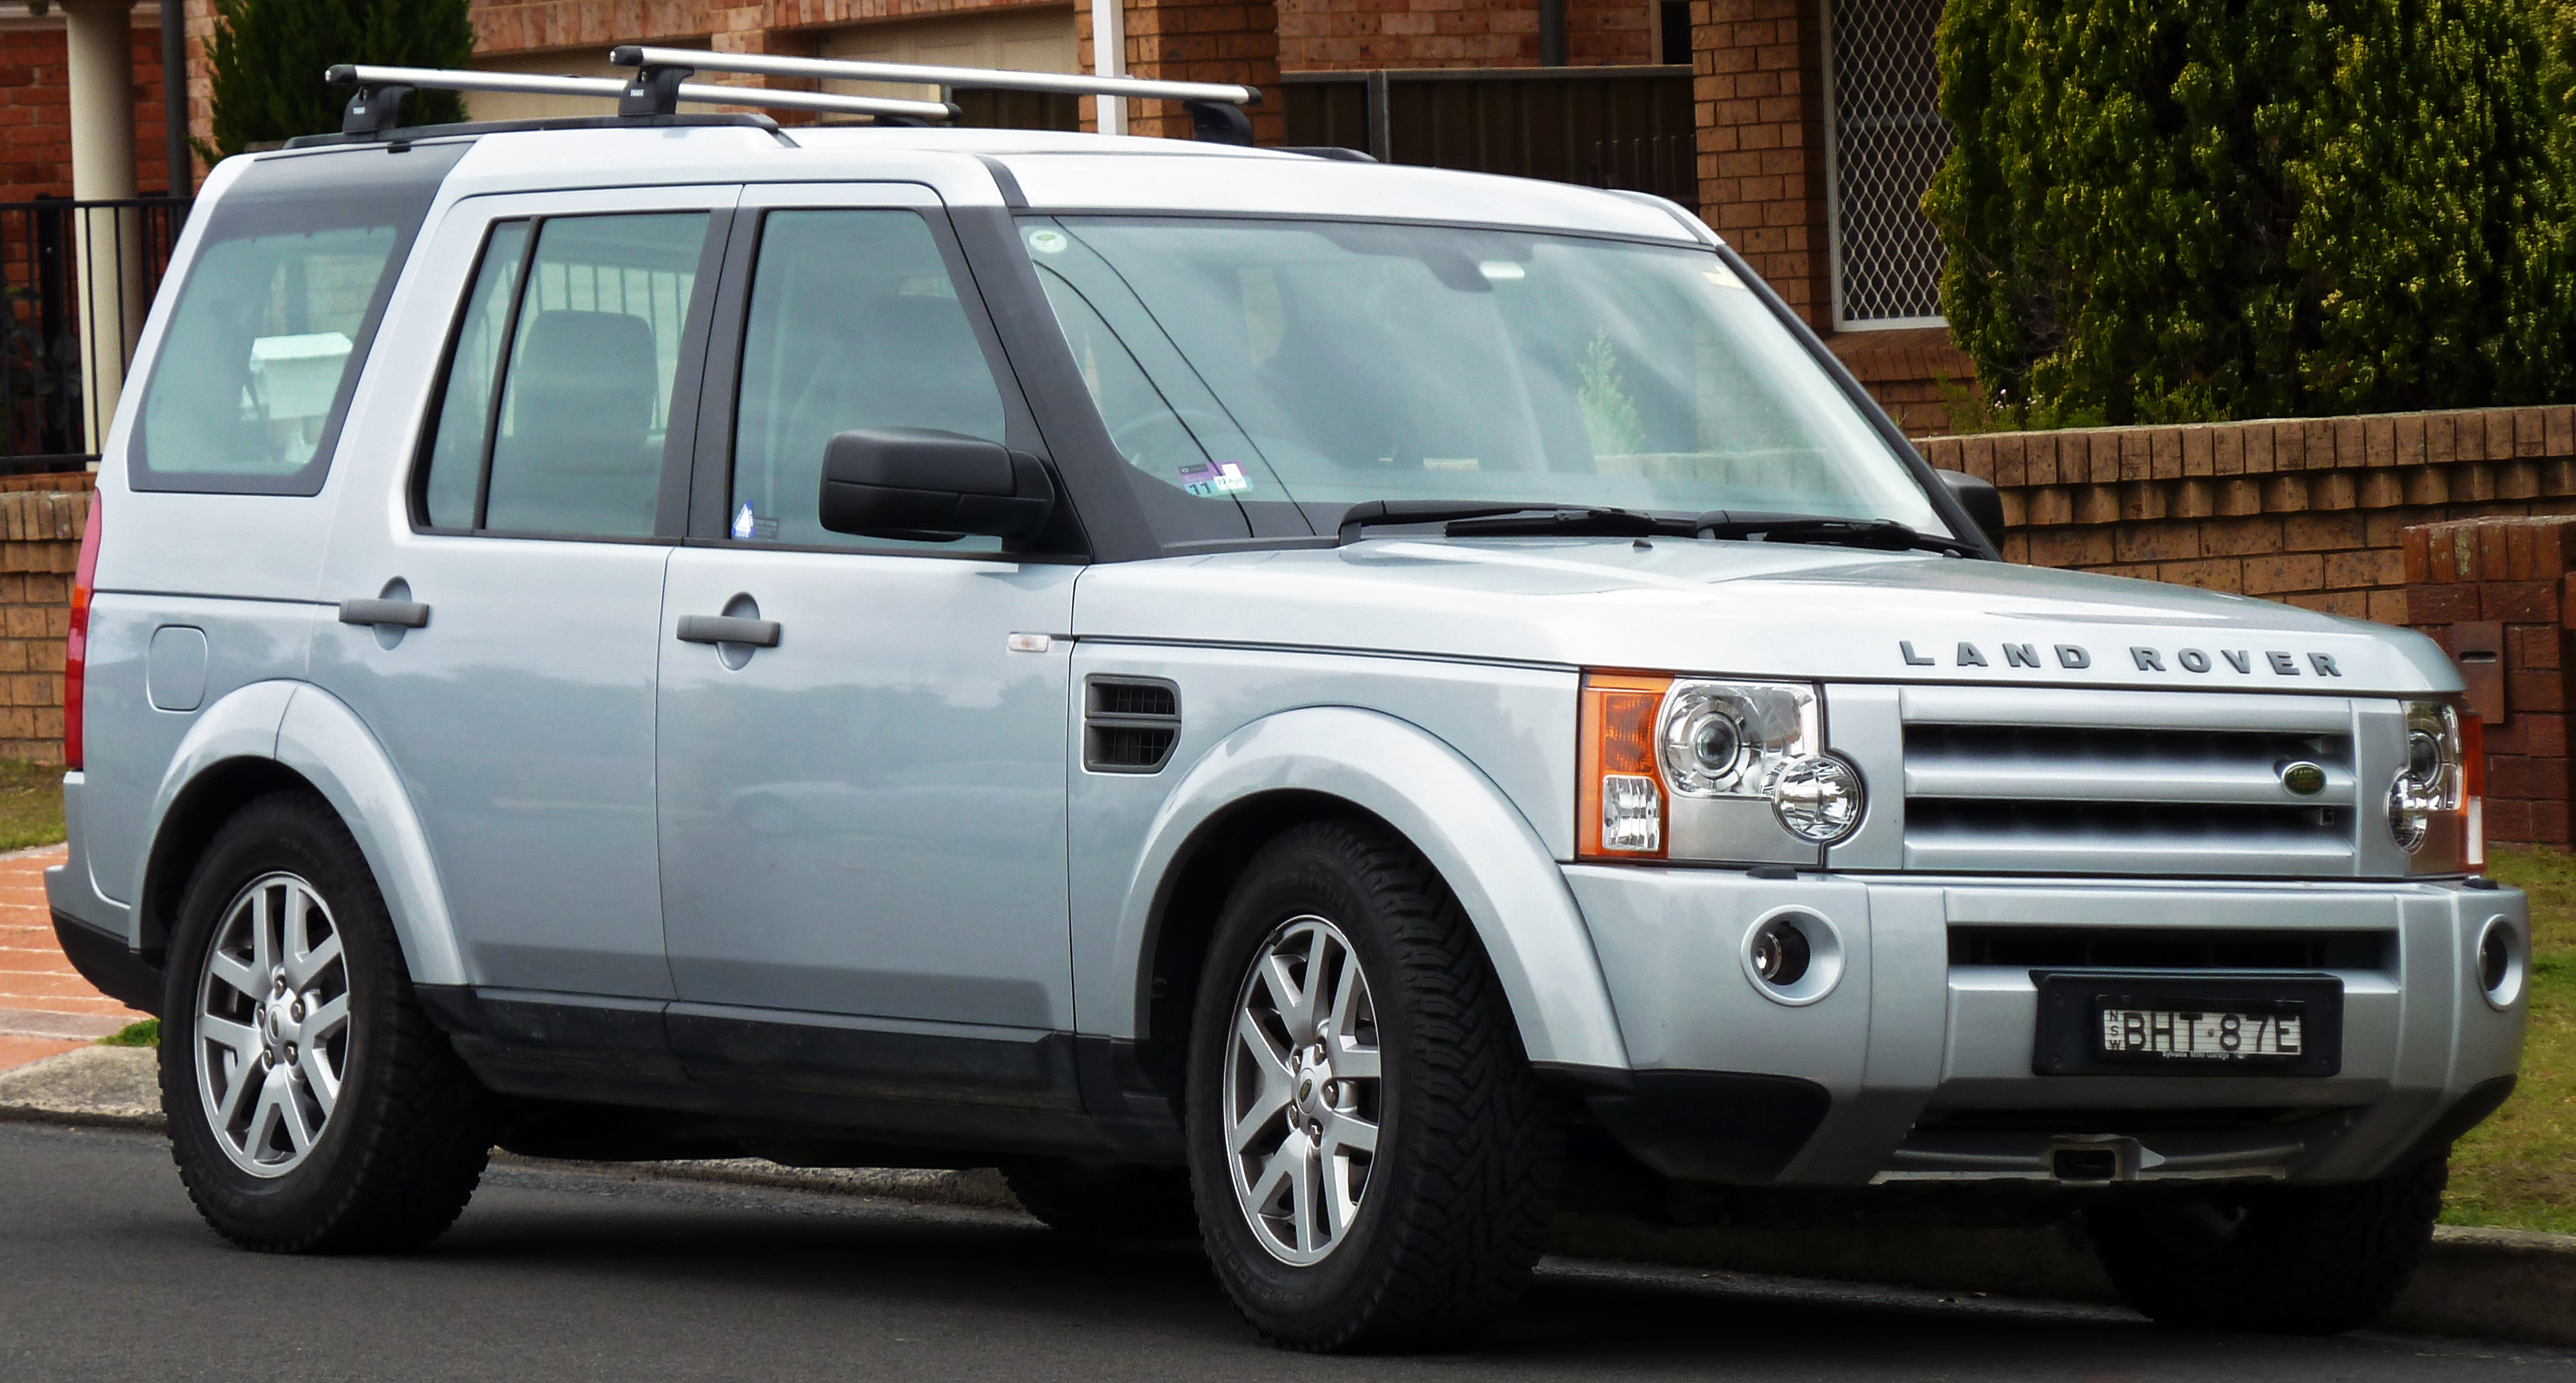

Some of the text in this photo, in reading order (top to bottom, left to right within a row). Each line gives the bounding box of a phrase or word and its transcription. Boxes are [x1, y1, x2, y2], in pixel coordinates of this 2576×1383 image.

[1190, 482, 1212, 495] 11
[1899, 640, 2342, 677] LAND ROVER
